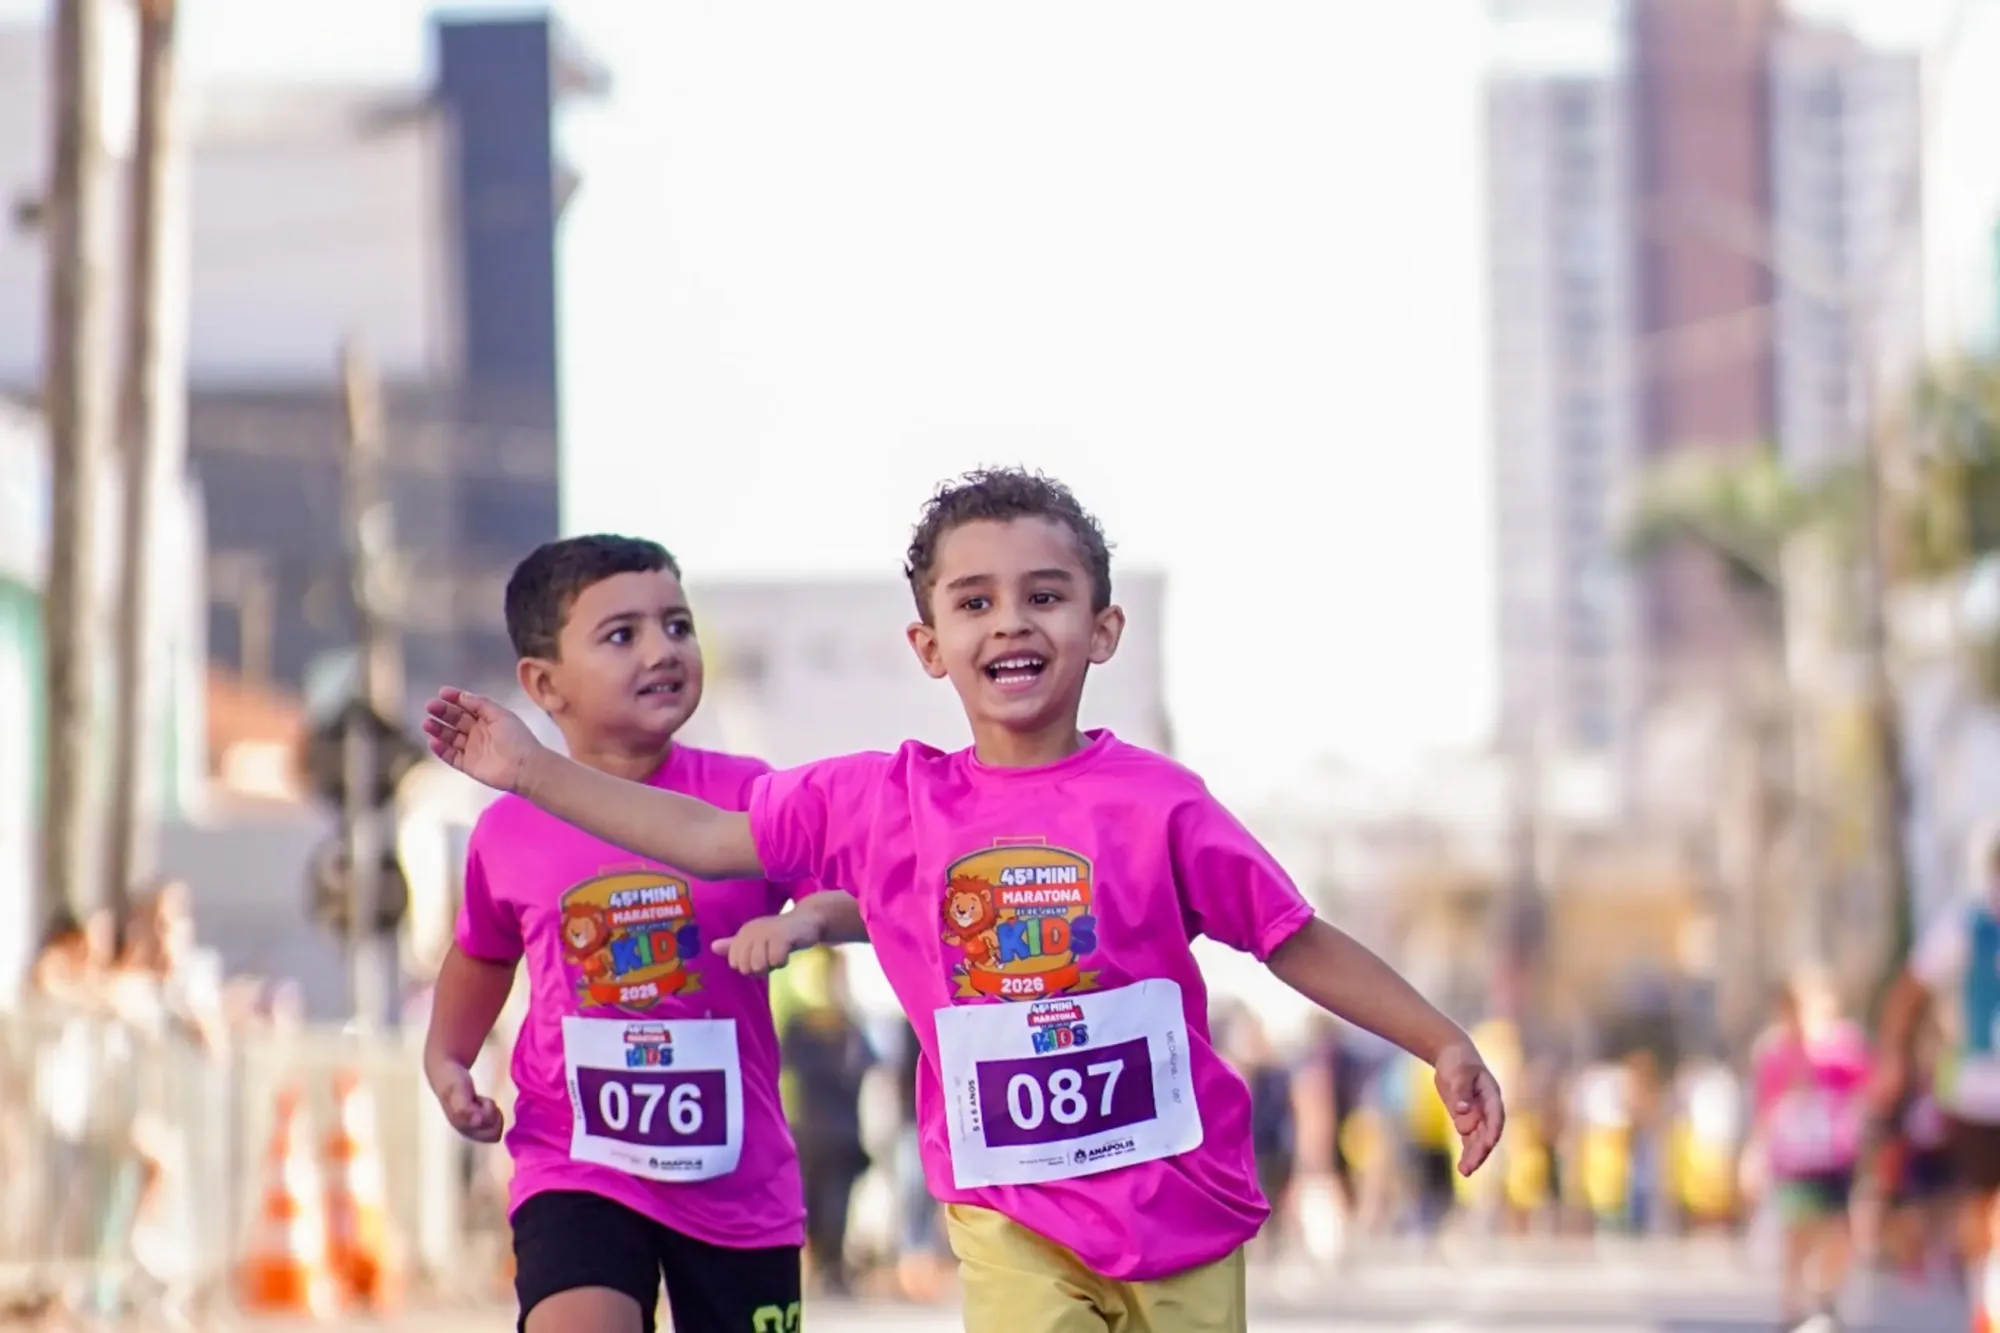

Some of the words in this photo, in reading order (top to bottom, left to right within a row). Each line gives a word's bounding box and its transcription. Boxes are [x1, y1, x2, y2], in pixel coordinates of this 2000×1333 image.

[1036, 866, 1077, 884] MINI
[640, 885, 677, 905] MINI
[1002, 888, 1082, 904] MARATONA
[612, 904, 684, 925] MARATONA
[996, 915, 1097, 963] KIDS
[611, 924, 701, 976] KIDS
[620, 982, 658, 1002] 2026
[1001, 976, 1045, 993] 2026
[1033, 1010, 1078, 1024] MARATONA
[1031, 1023, 1089, 1055] KIDS
[968, 1079, 977, 1107] ANOS
[1007, 1058, 1124, 1130] 087
[599, 1080, 704, 1134] 076
